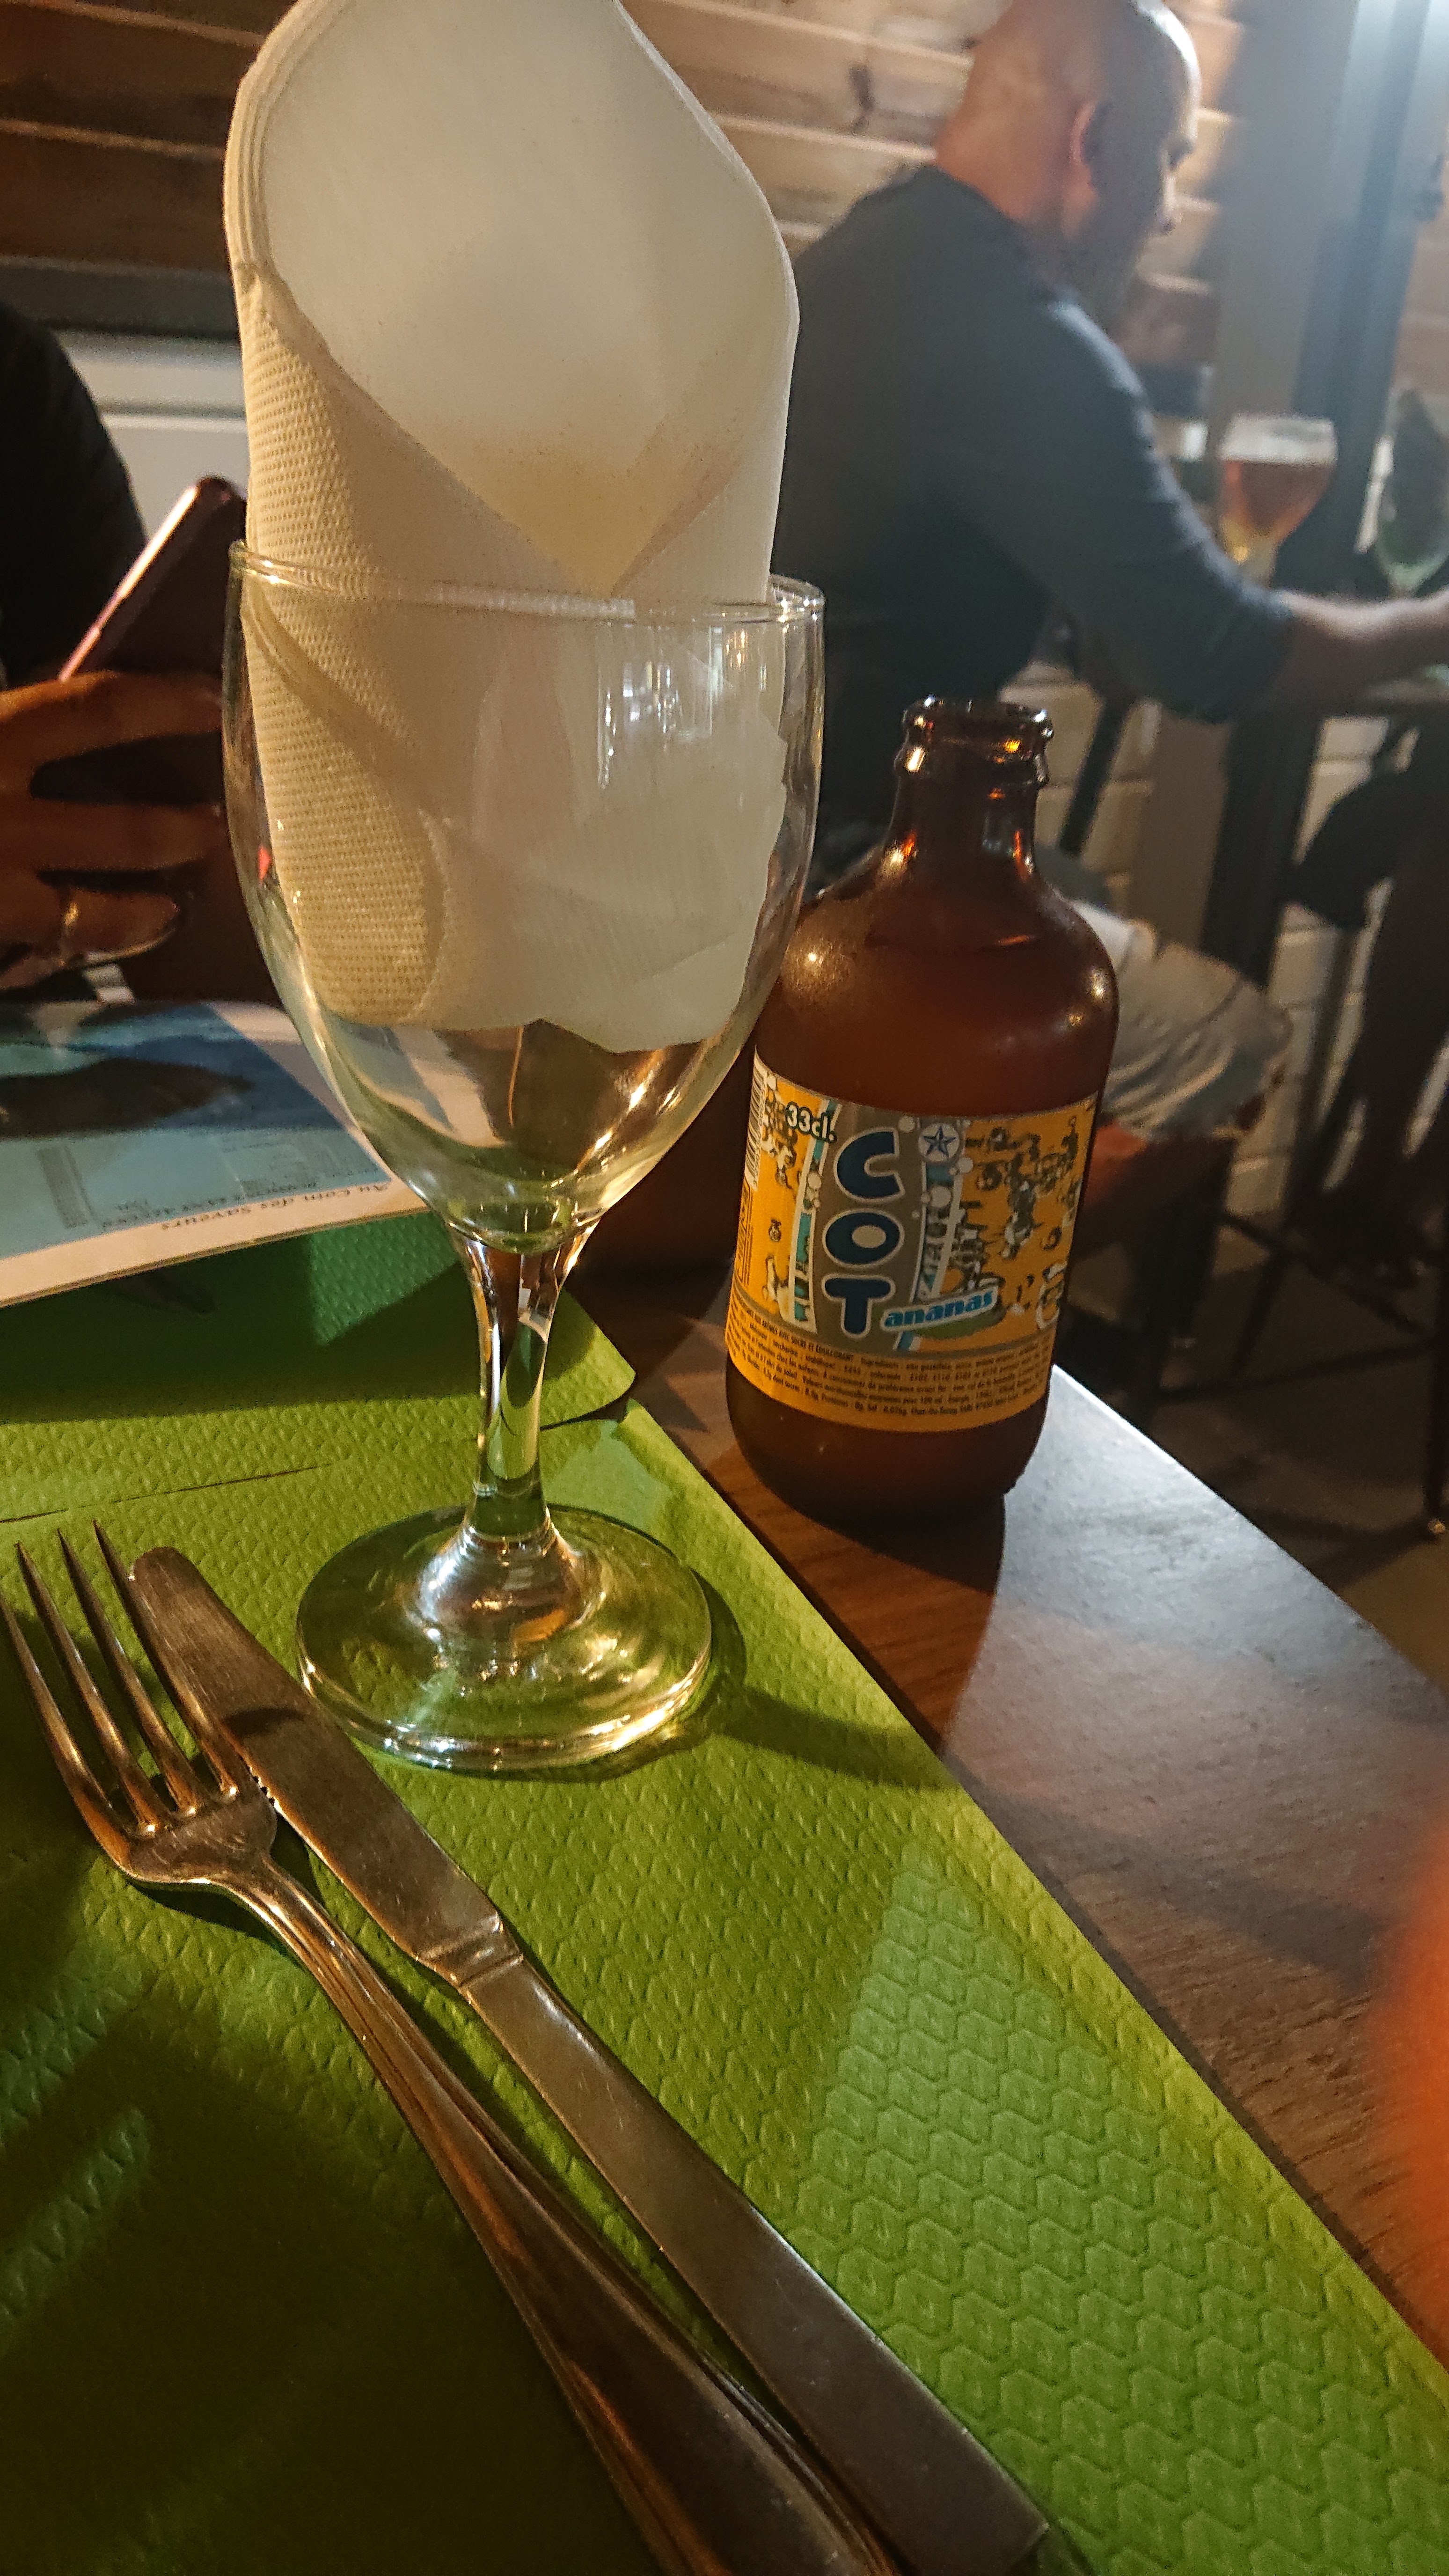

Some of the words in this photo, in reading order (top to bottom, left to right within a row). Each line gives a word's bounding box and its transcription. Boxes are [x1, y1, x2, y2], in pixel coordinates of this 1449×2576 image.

[785, 1101, 837, 1143] 33cl.
[822, 1127, 904, 1339] COT
[884, 1290, 993, 1328] ananas
